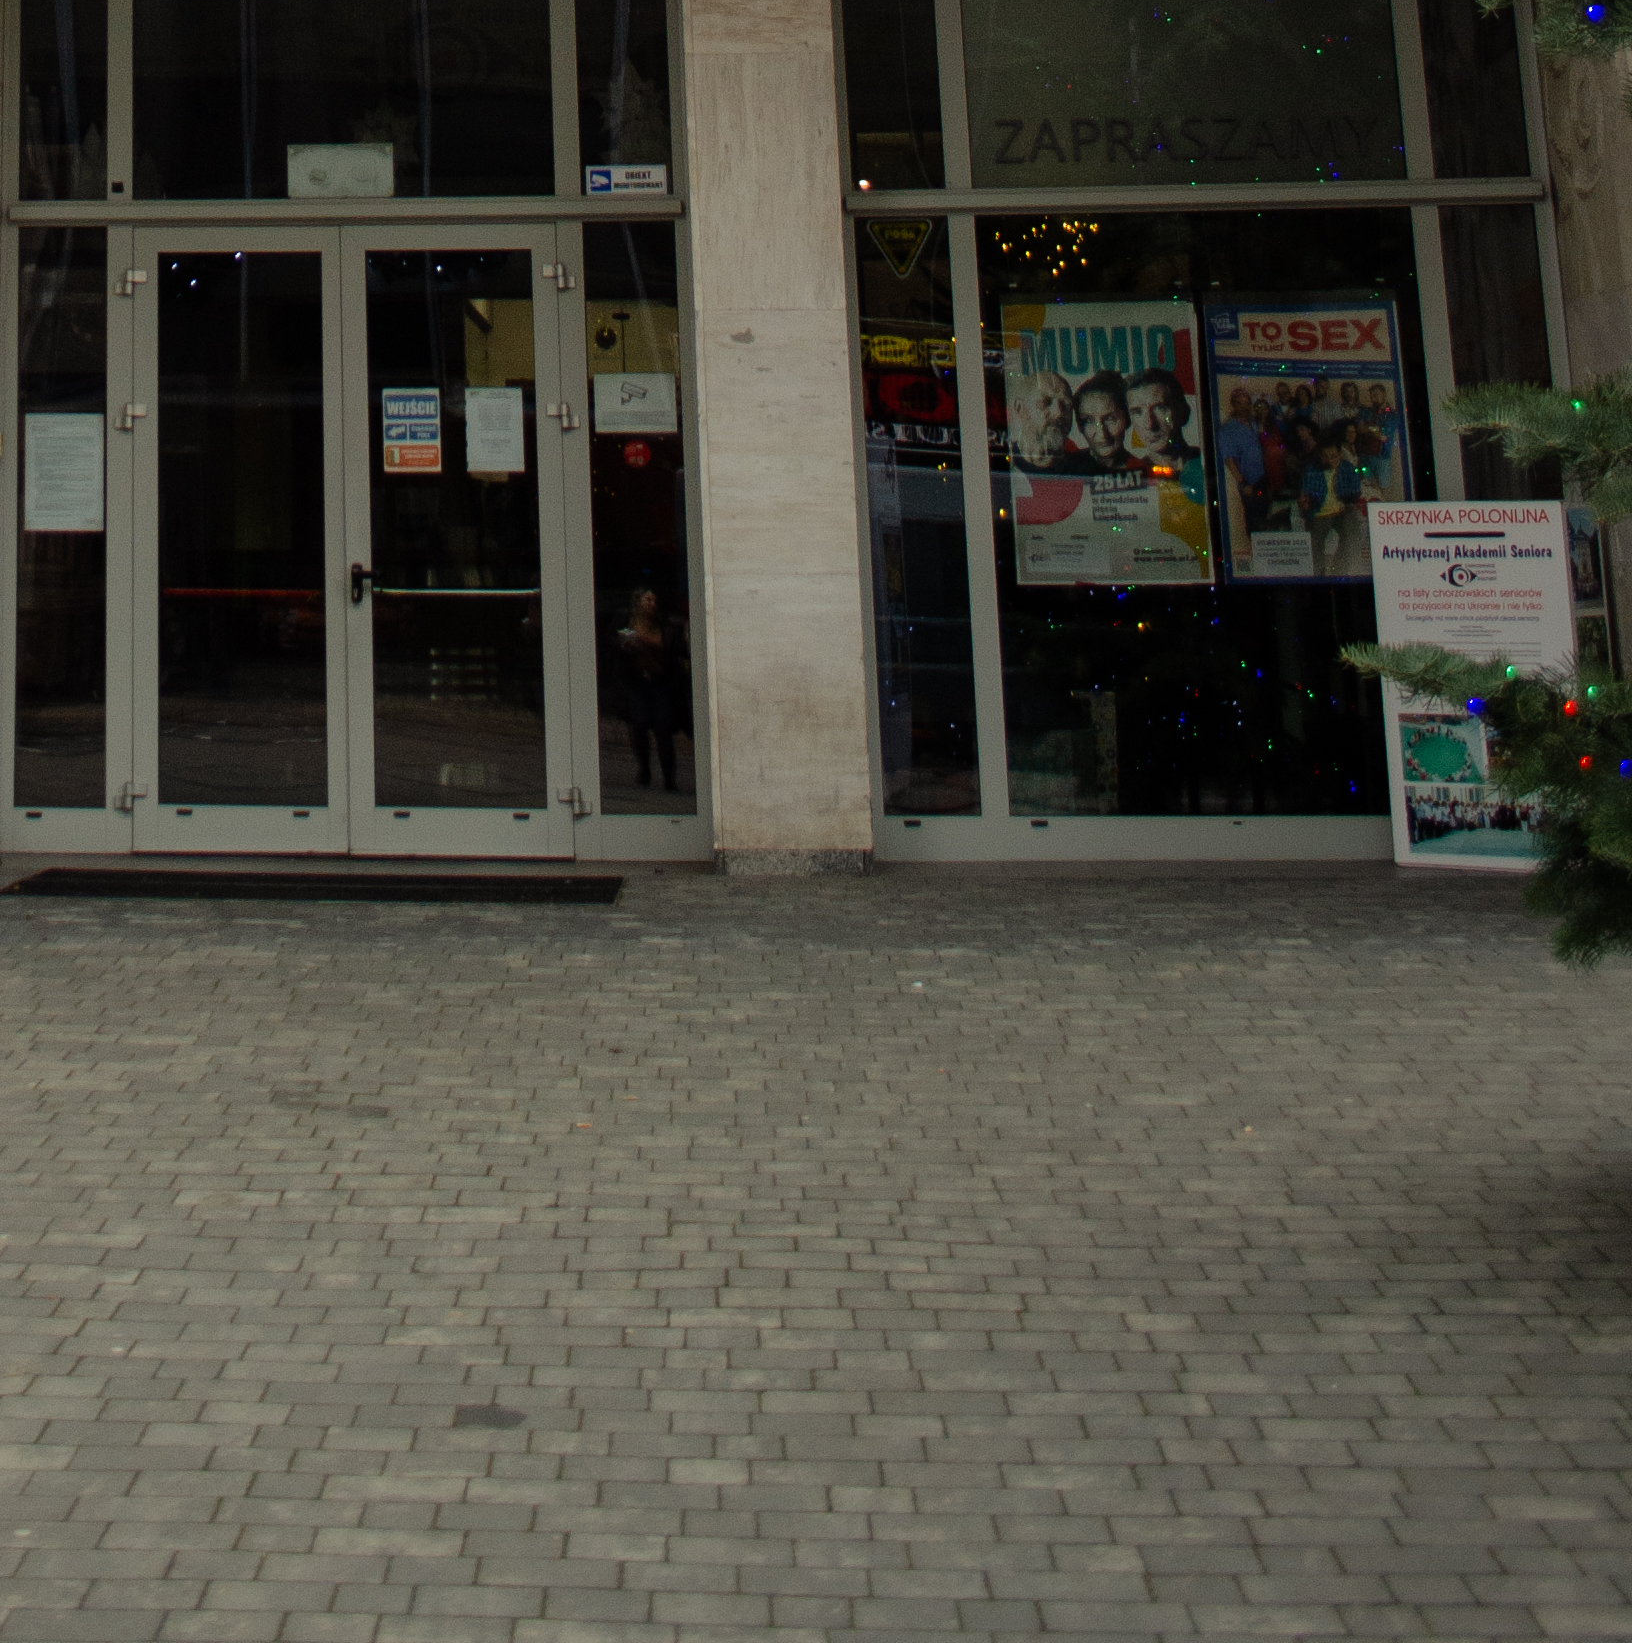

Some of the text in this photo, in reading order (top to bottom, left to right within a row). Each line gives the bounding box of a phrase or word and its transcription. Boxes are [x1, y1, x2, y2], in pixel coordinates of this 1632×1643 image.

[995, 116, 1379, 164] ZAPRASZAMY
[1243, 318, 1385, 353] TO SEX
[1019, 325, 1176, 375] MUMIO
[387, 399, 436, 416] WEJŚCIE
[1093, 470, 1143, 491] 25 LAT
[1377, 508, 1550, 525] SKRZYNKA POLONIJNA
[1382, 544, 1552, 562] Artystycznej Akademii Seniora
[1397, 588, 1542, 599] na listy chorzowskich seniorów
[1398, 601, 1410, 610] do
[1467, 601, 1501, 610] Ukrainie
